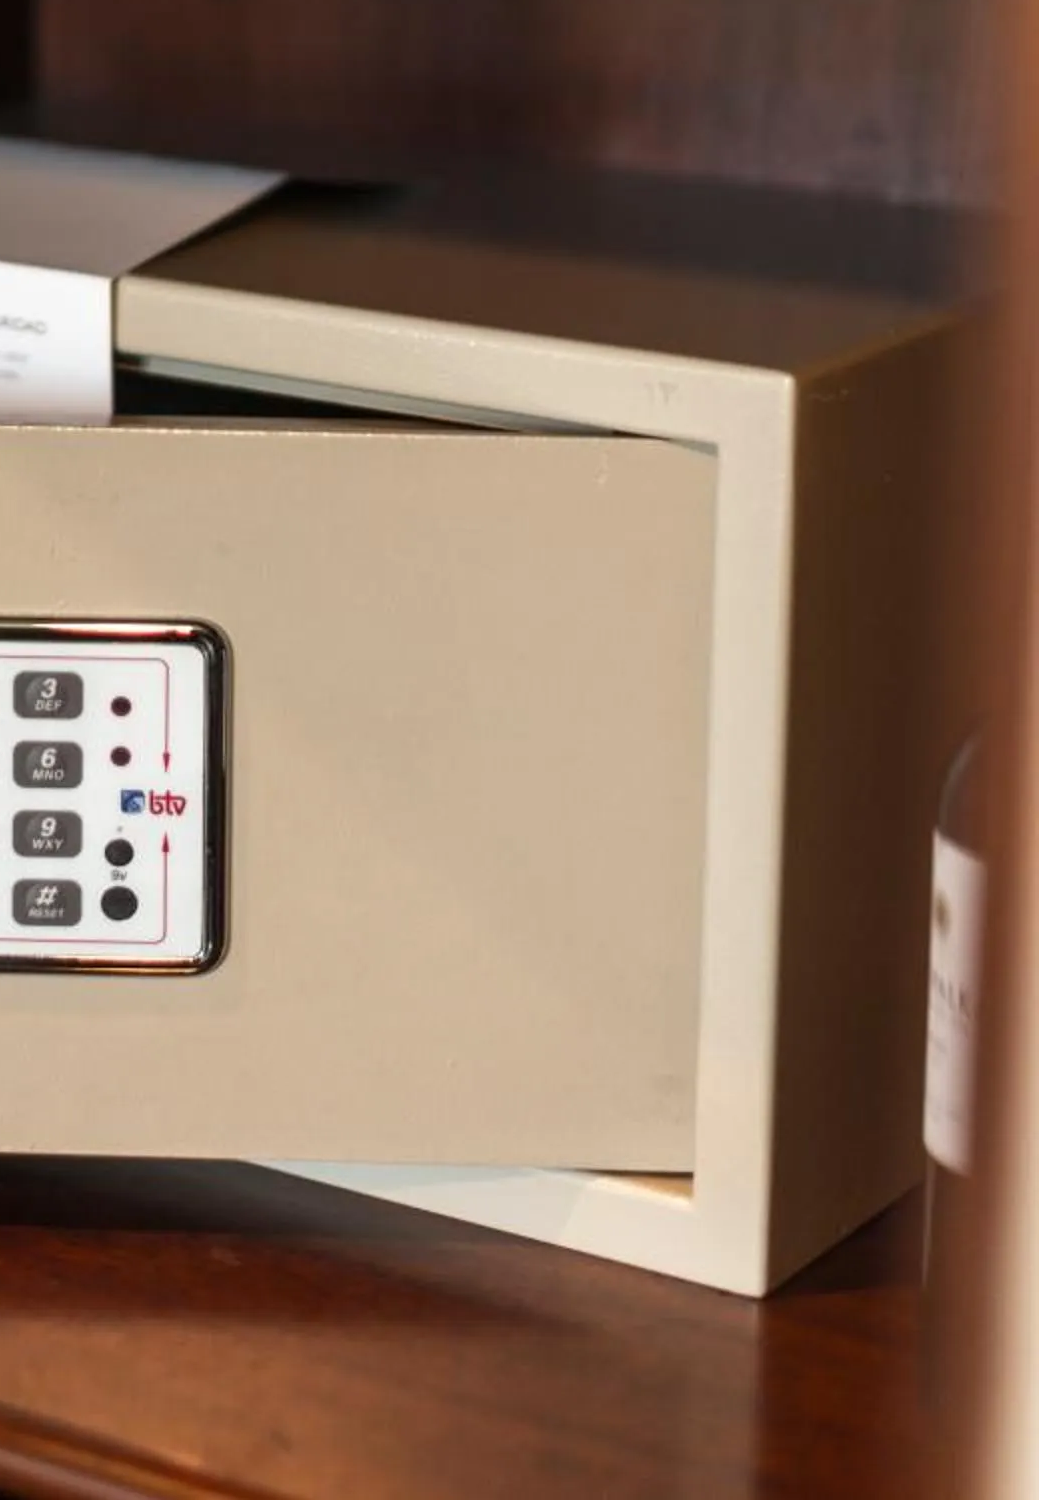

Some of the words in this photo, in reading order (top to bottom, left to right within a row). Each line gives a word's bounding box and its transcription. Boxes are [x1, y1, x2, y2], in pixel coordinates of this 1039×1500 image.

[40, 677, 57, 699] 3
[34, 699, 63, 712] DEF
[40, 747, 57, 769] 6
[32, 768, 65, 782] MNO
[148, 789, 187, 816] btv
[40, 816, 57, 838] 9
[32, 838, 65, 851] WXY
[35, 885, 58, 906] #
